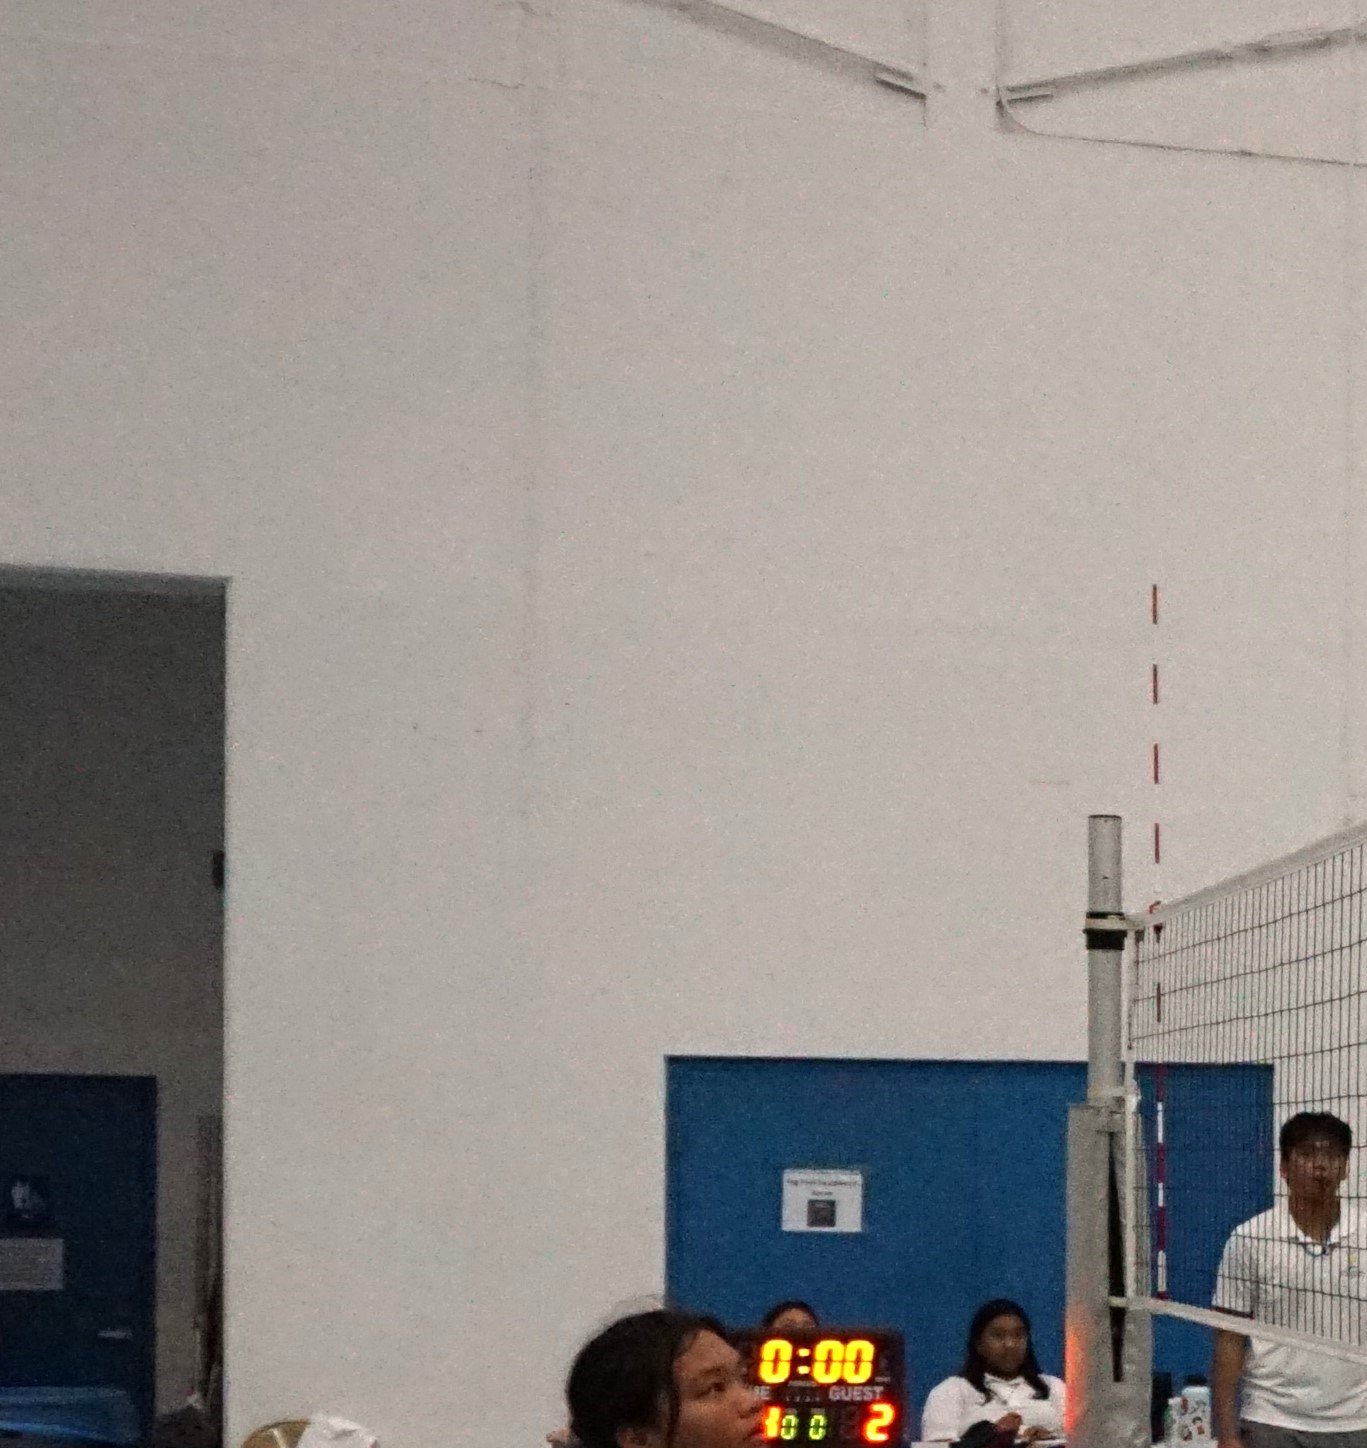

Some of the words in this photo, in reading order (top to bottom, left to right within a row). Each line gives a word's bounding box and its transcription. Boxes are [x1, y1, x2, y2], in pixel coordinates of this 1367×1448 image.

[758, 1338, 875, 1384] 0:00
[828, 1385, 884, 1402] GUEST
[808, 1414, 827, 1441] 0
[864, 1403, 896, 1442] 2
